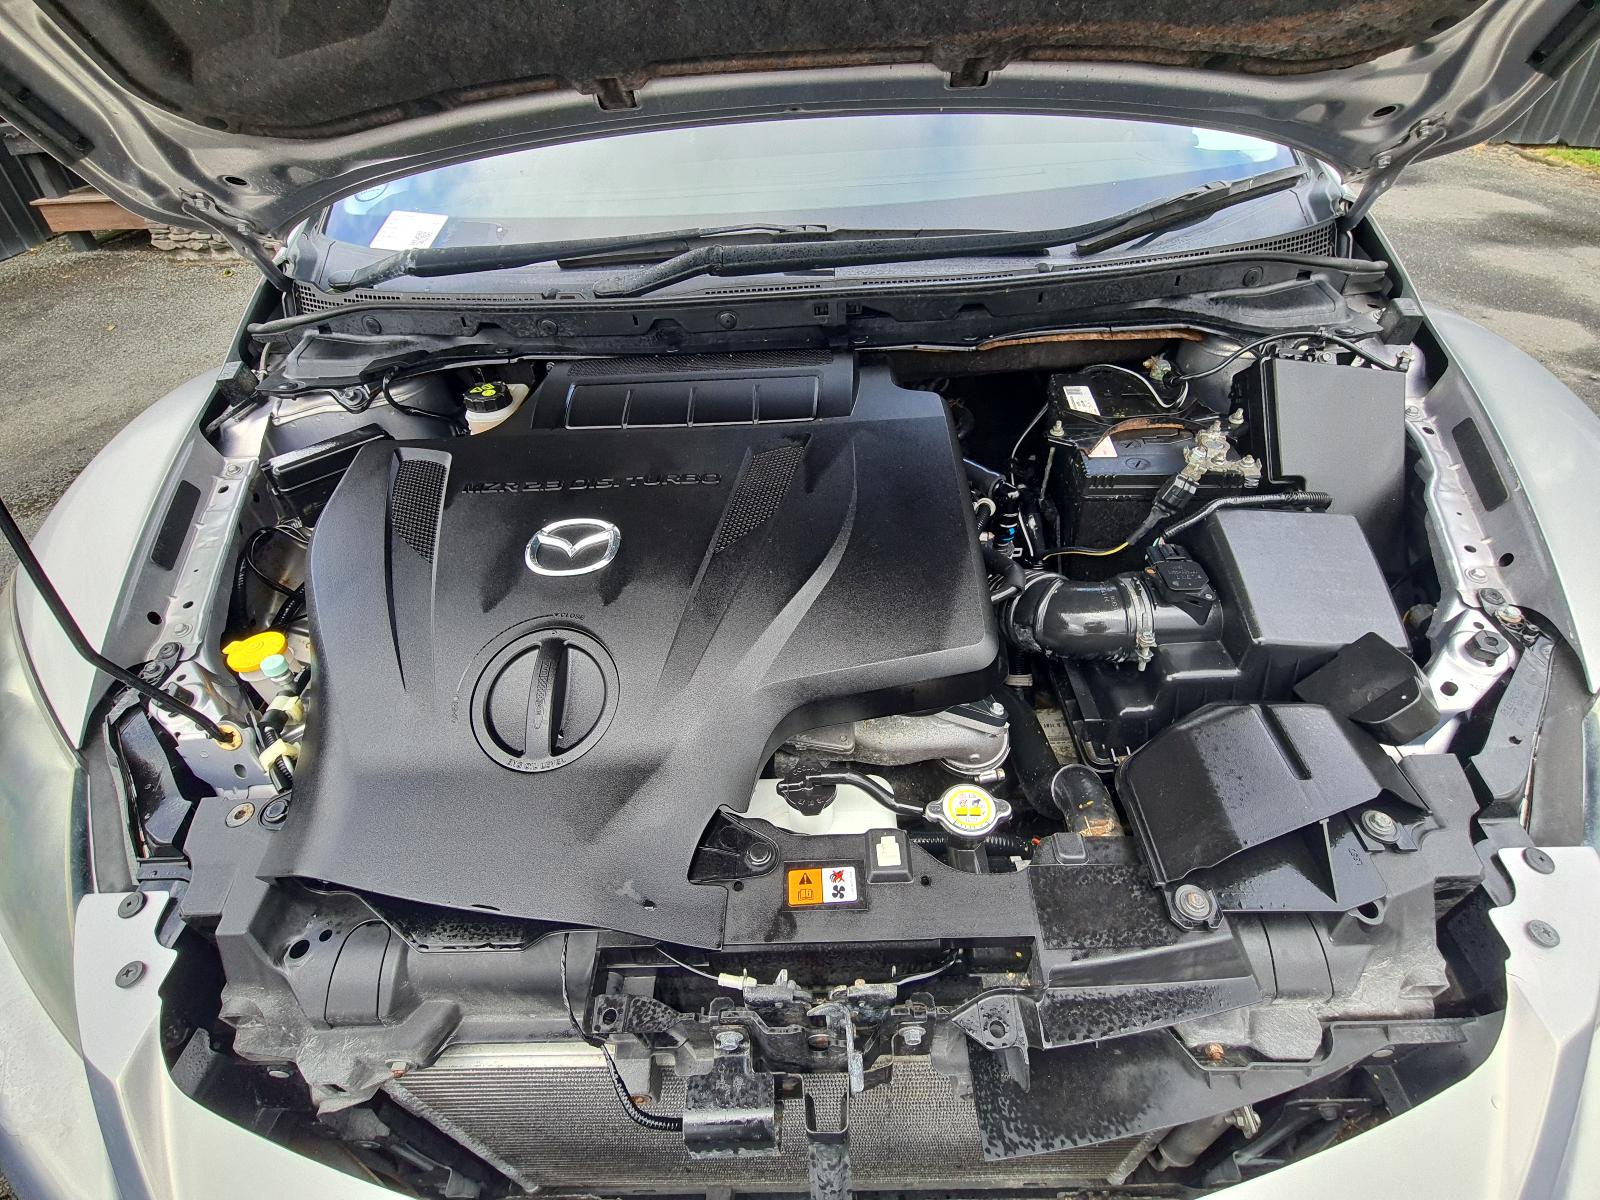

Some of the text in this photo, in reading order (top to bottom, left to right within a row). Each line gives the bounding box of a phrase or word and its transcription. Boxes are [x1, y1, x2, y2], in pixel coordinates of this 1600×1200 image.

[460, 481, 520, 495] MZR
[521, 480, 564, 493] 2.3
[623, 471, 722, 487] TURBO
[560, 611, 586, 621] CLOSE
